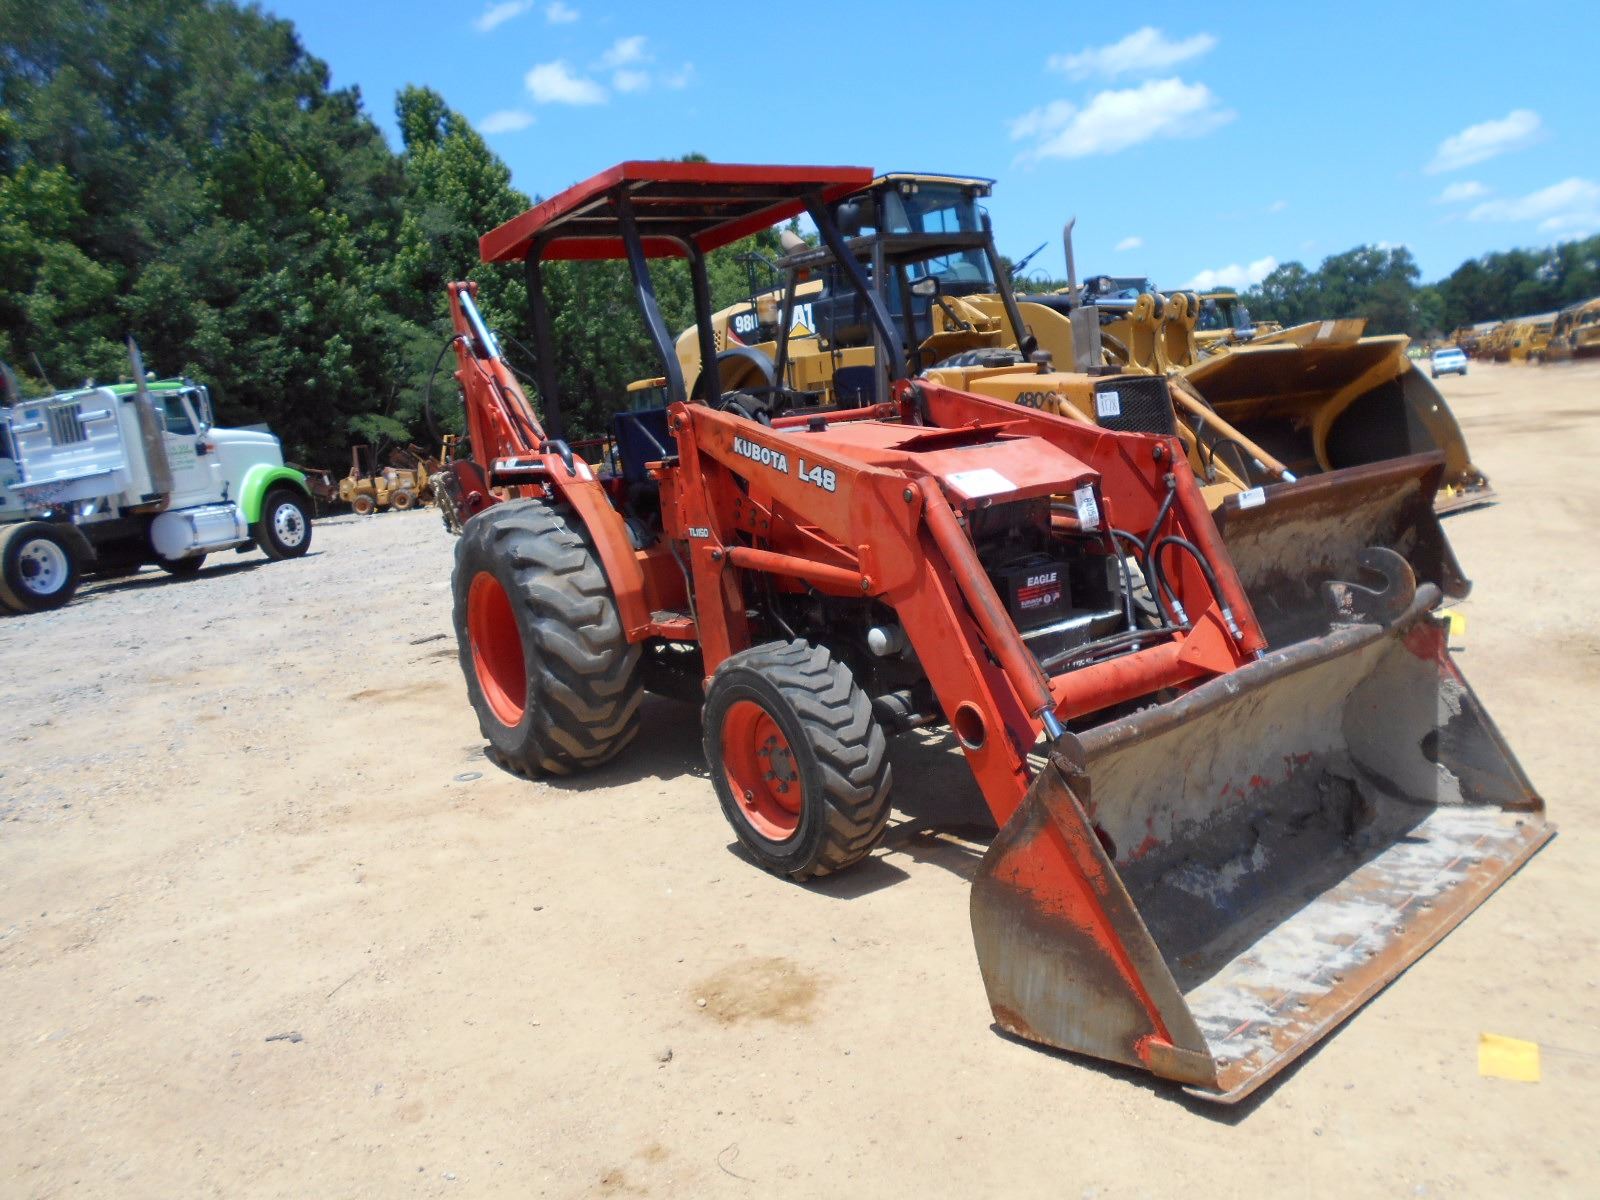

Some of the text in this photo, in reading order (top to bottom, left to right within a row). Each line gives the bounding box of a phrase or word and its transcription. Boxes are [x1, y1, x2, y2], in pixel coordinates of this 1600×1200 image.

[733, 436, 836, 492] KUBOTA L48
[1027, 572, 1057, 587] EAGLE
